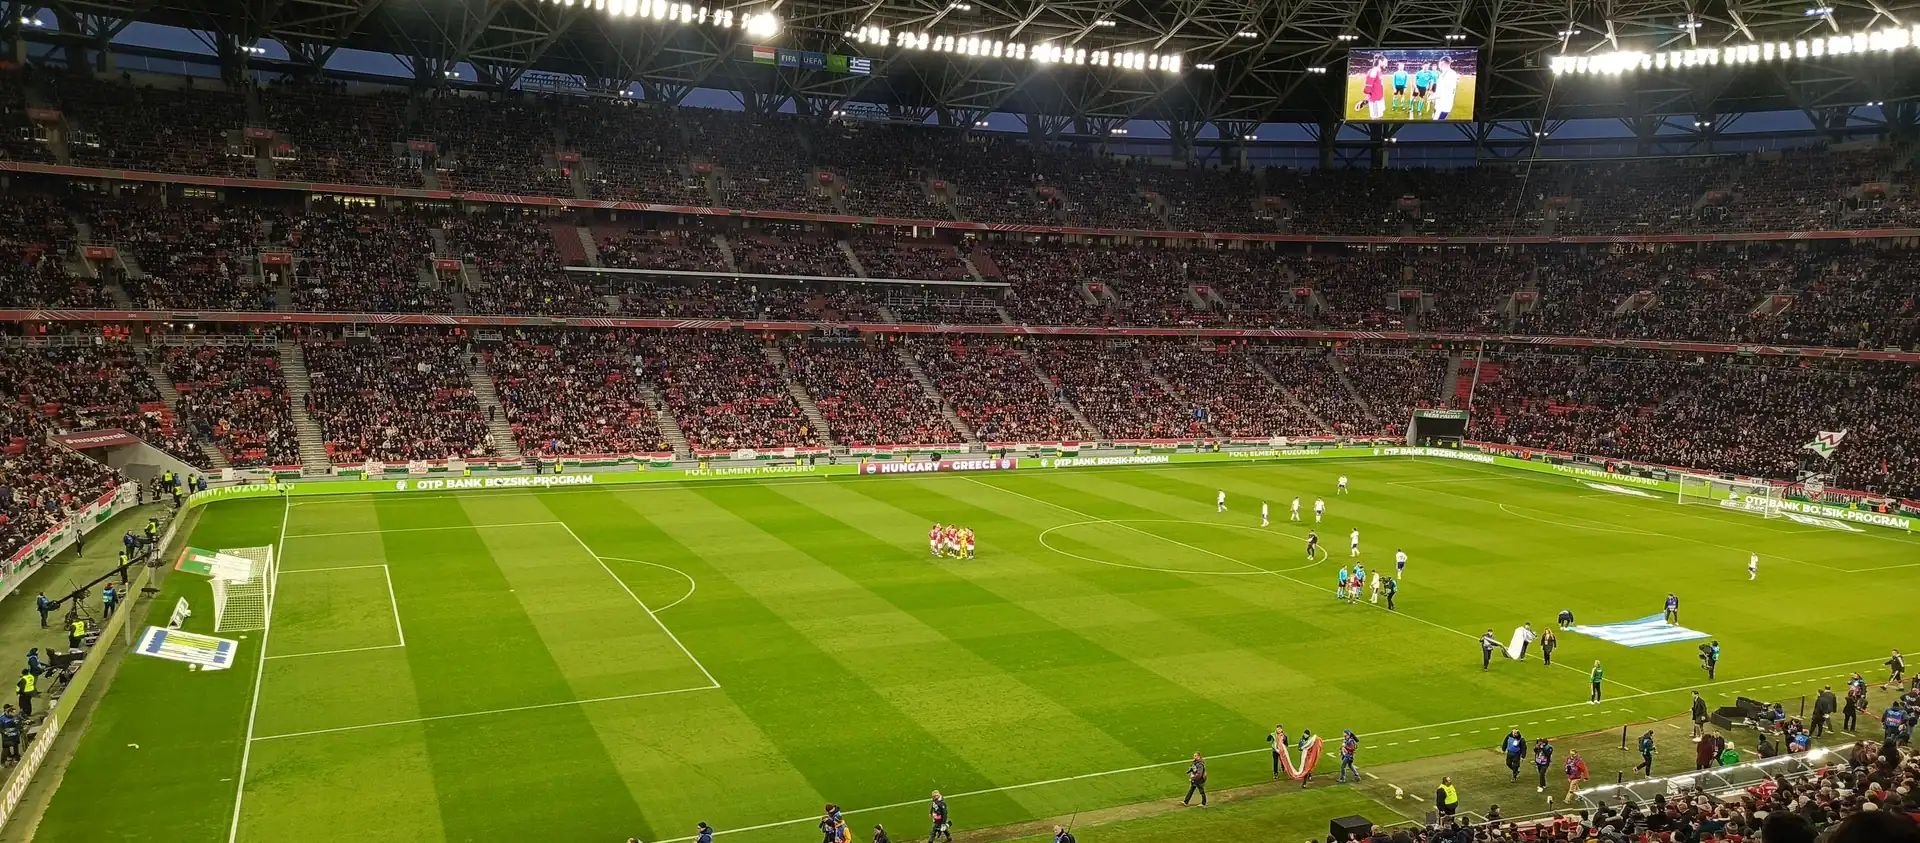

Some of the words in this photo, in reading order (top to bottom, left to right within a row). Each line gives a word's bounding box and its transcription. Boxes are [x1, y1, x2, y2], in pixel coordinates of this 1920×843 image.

[781, 54, 797, 63] FIFA
[803, 56, 823, 66] UEFA
[1054, 459, 1071, 467] OTP
[1072, 457, 1097, 466] BANK
[1098, 455, 1169, 465] BOZSIK-PROGRAM
[1400, 448, 1425, 456] BANK
[1426, 448, 1494, 464] BOZSIK-PROGRAM
[881, 461, 940, 473] HUNGARY
[952, 460, 997, 470] GREECE
[417, 479, 443, 490] OTP
[446, 477, 482, 489] BANK
[485, 474, 593, 487] BOZSIK-PROGRAM
[1745, 495, 1767, 506] OTP
[1769, 498, 1799, 512] BANK
